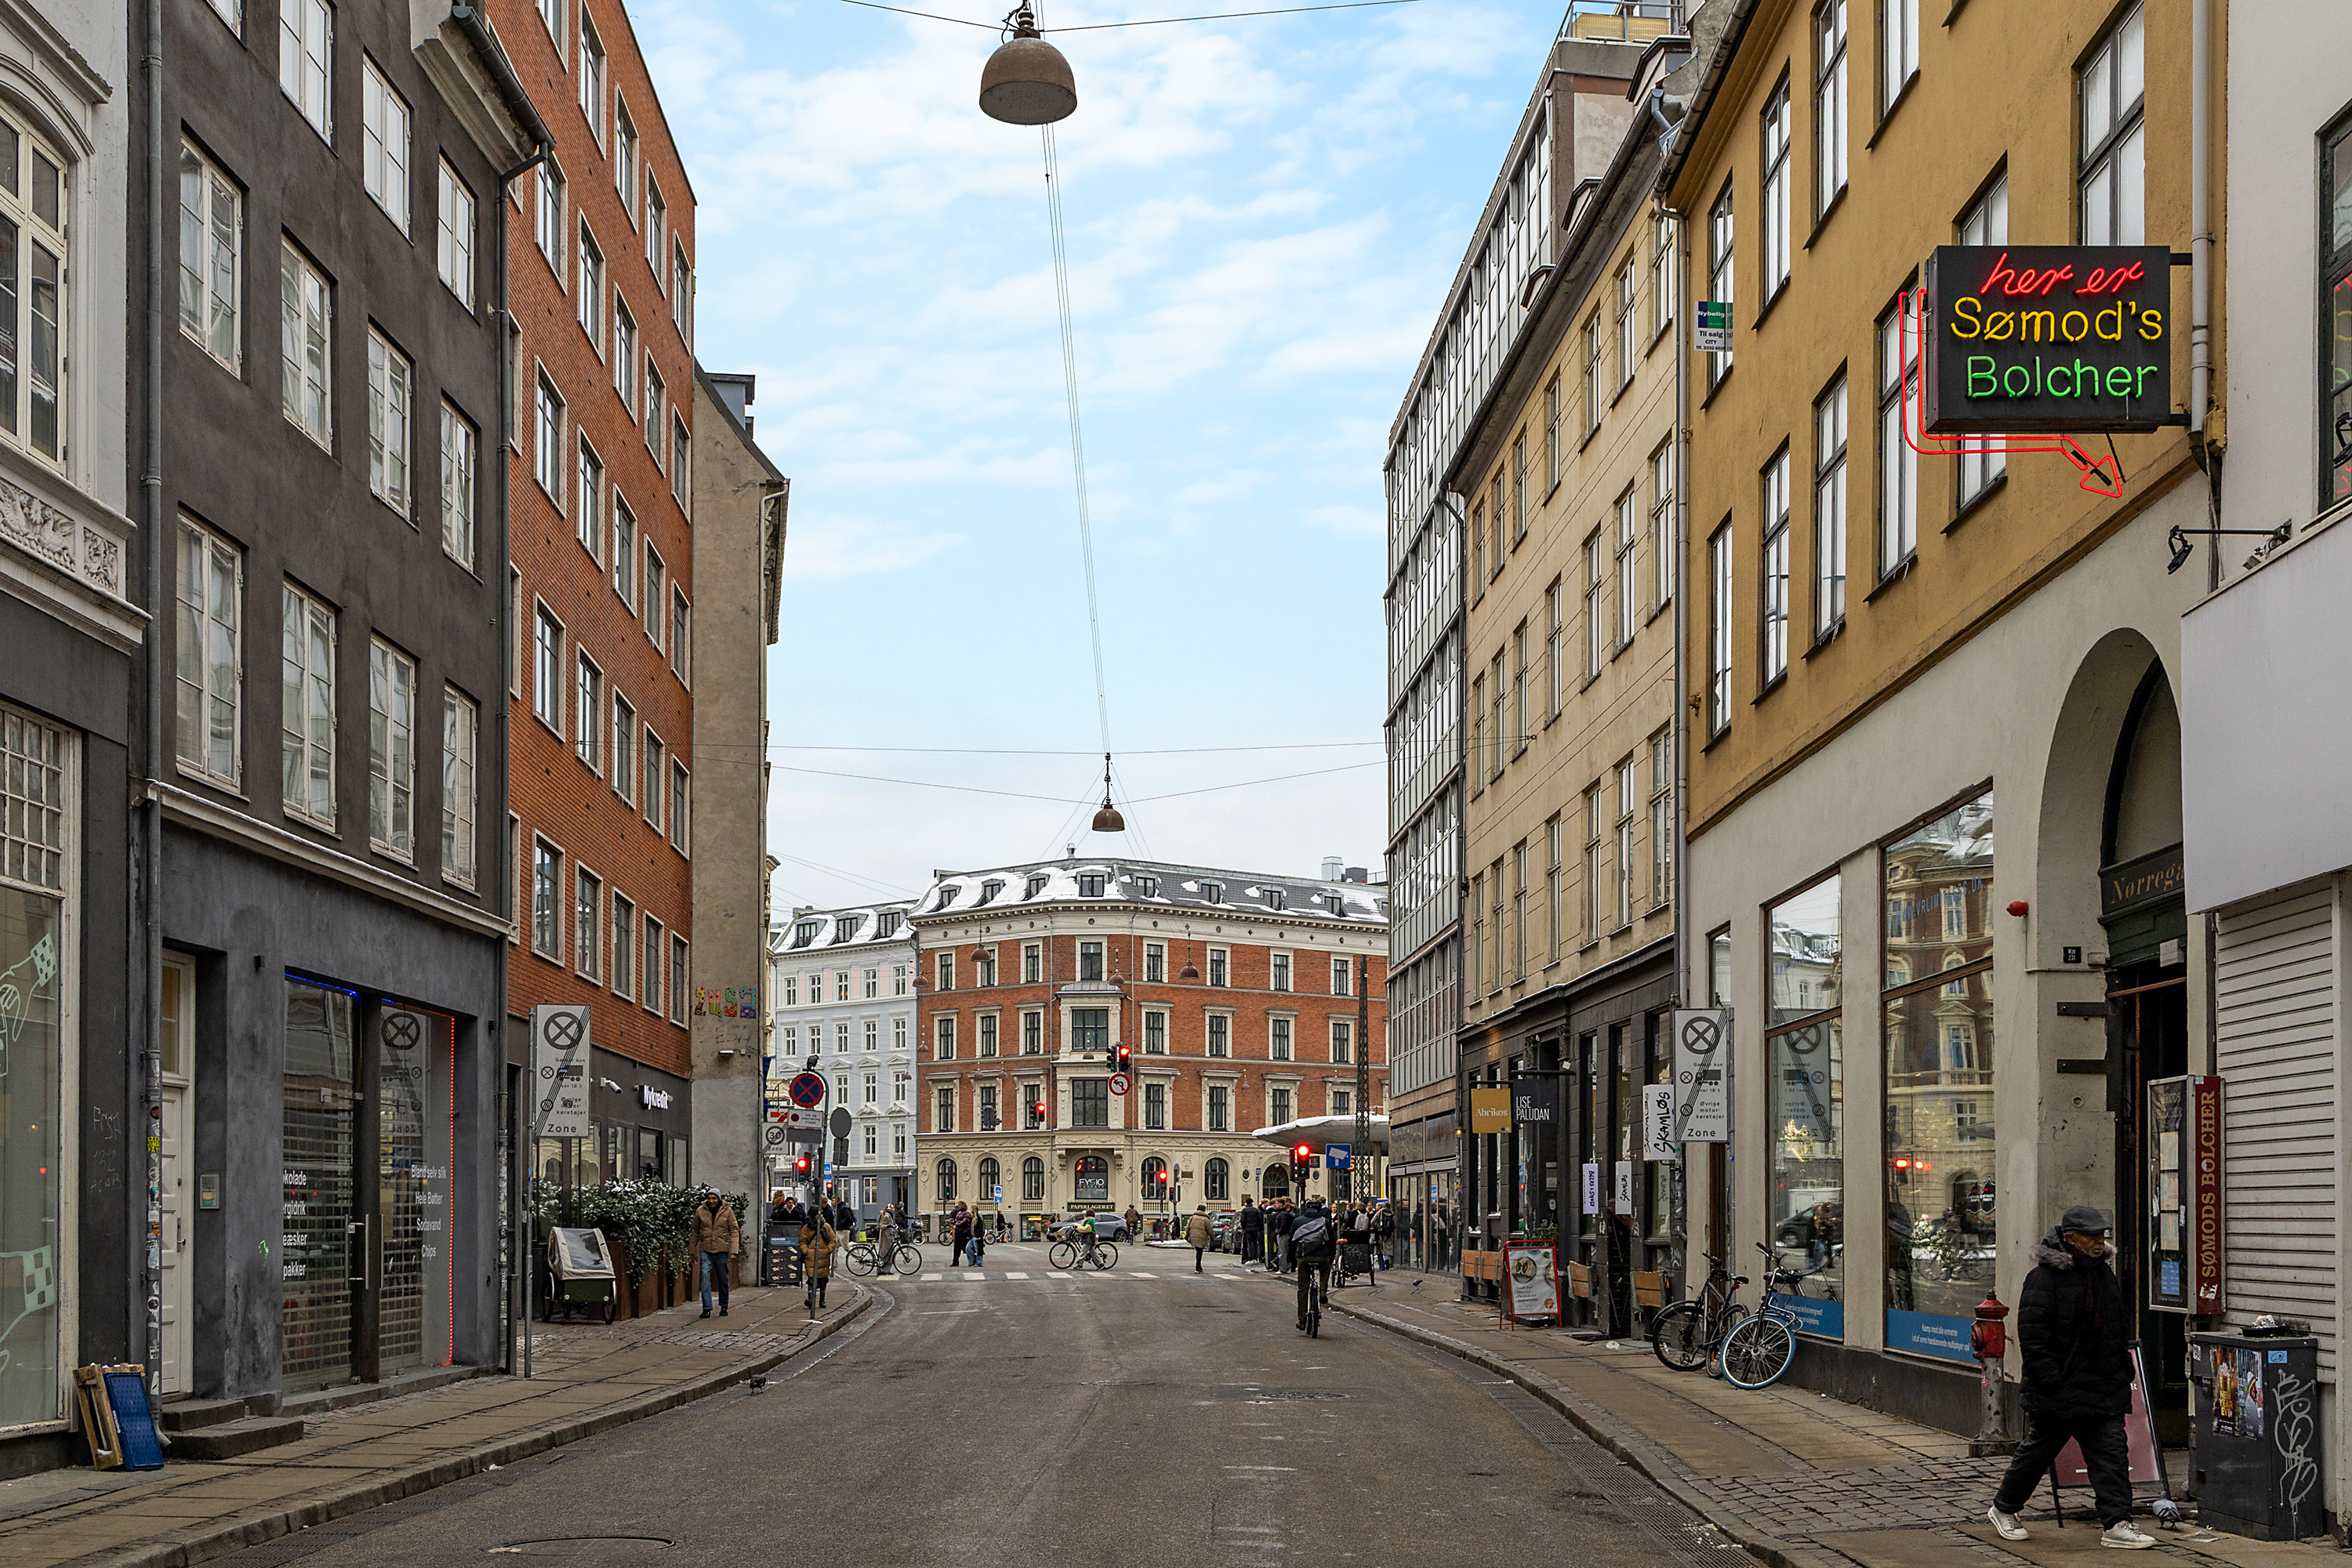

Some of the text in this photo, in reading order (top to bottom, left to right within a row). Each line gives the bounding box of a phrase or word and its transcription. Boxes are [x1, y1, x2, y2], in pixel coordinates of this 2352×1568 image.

[1980, 252, 2145, 296] her er
[1951, 296, 2162, 342] Sømod's
[1967, 356, 2158, 397] Bolcher
[644, 1085, 668, 1110] Nykredit
[1515, 1096, 1531, 1109] LISE
[1475, 1108, 1508, 1116] Abrikos
[1516, 1109, 1549, 1120] PALUDAN
[547, 1124, 577, 1133] Zone
[1654, 1091, 1676, 1153] SKAMLØS
[769, 1131, 782, 1140] 30
[411, 1164, 447, 1179] Bland selv slik
[2200, 1091, 2218, 1277] SØMODS BOLCHER
[415, 1192, 427, 1204] Hele
[416, 1218, 441, 1231] Sodavand
[421, 1244, 437, 1260] Chips
